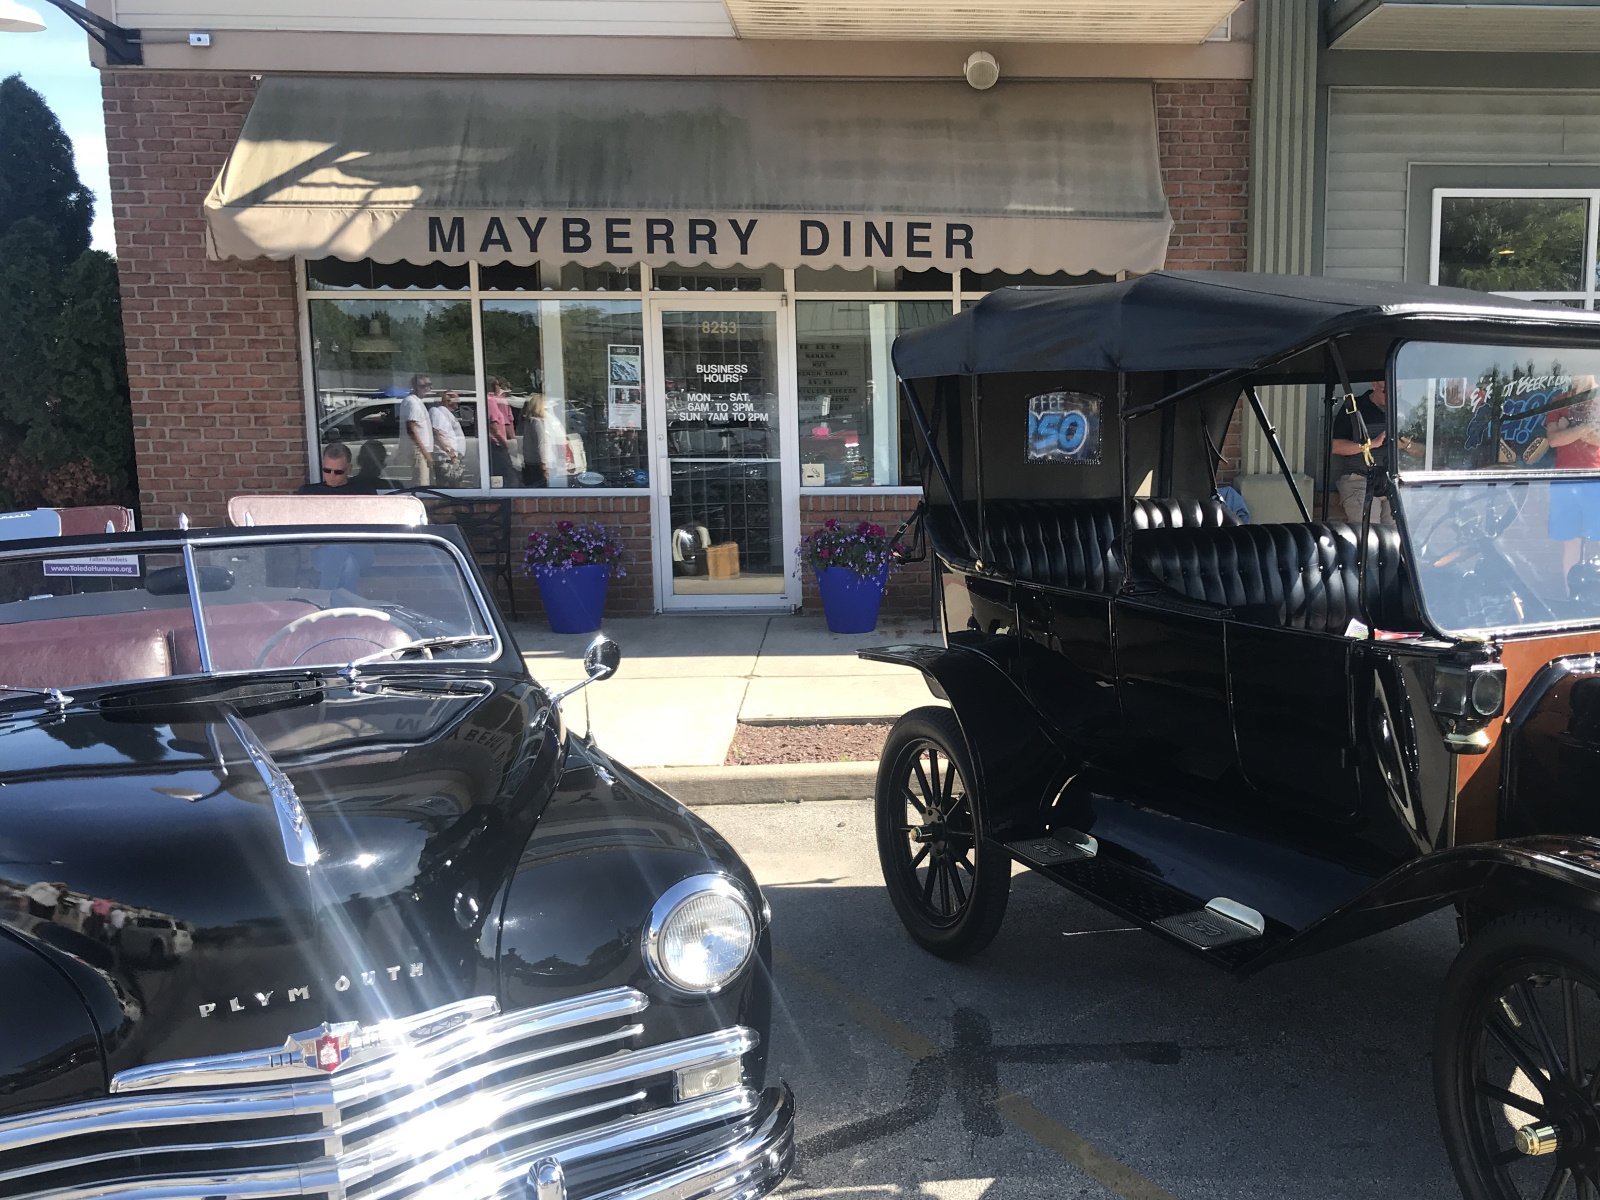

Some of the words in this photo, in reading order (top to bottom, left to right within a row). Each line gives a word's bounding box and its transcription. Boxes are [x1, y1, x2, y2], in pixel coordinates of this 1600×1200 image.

[428, 216, 758, 255] MAYBERRY
[800, 220, 975, 259] DINER
[702, 321, 737, 334] 8253
[696, 364, 748, 374] BUSINESS
[703, 374, 743, 383] HOURS:
[687, 393, 715, 402] MON.
[729, 393, 751, 402] SAT.
[687, 403, 709, 412] 6AM
[715, 403, 729, 412] TO
[732, 403, 754, 412] 3PM
[679, 412, 703, 422] SUN.
[707, 412, 729, 421] 7AM
[732, 413, 746, 421] TO
[748, 412, 769, 422] 2PM
[51, 565, 133, 574] www.ToledoHumane.org
[199, 962, 424, 1018] PLYMOUTH
